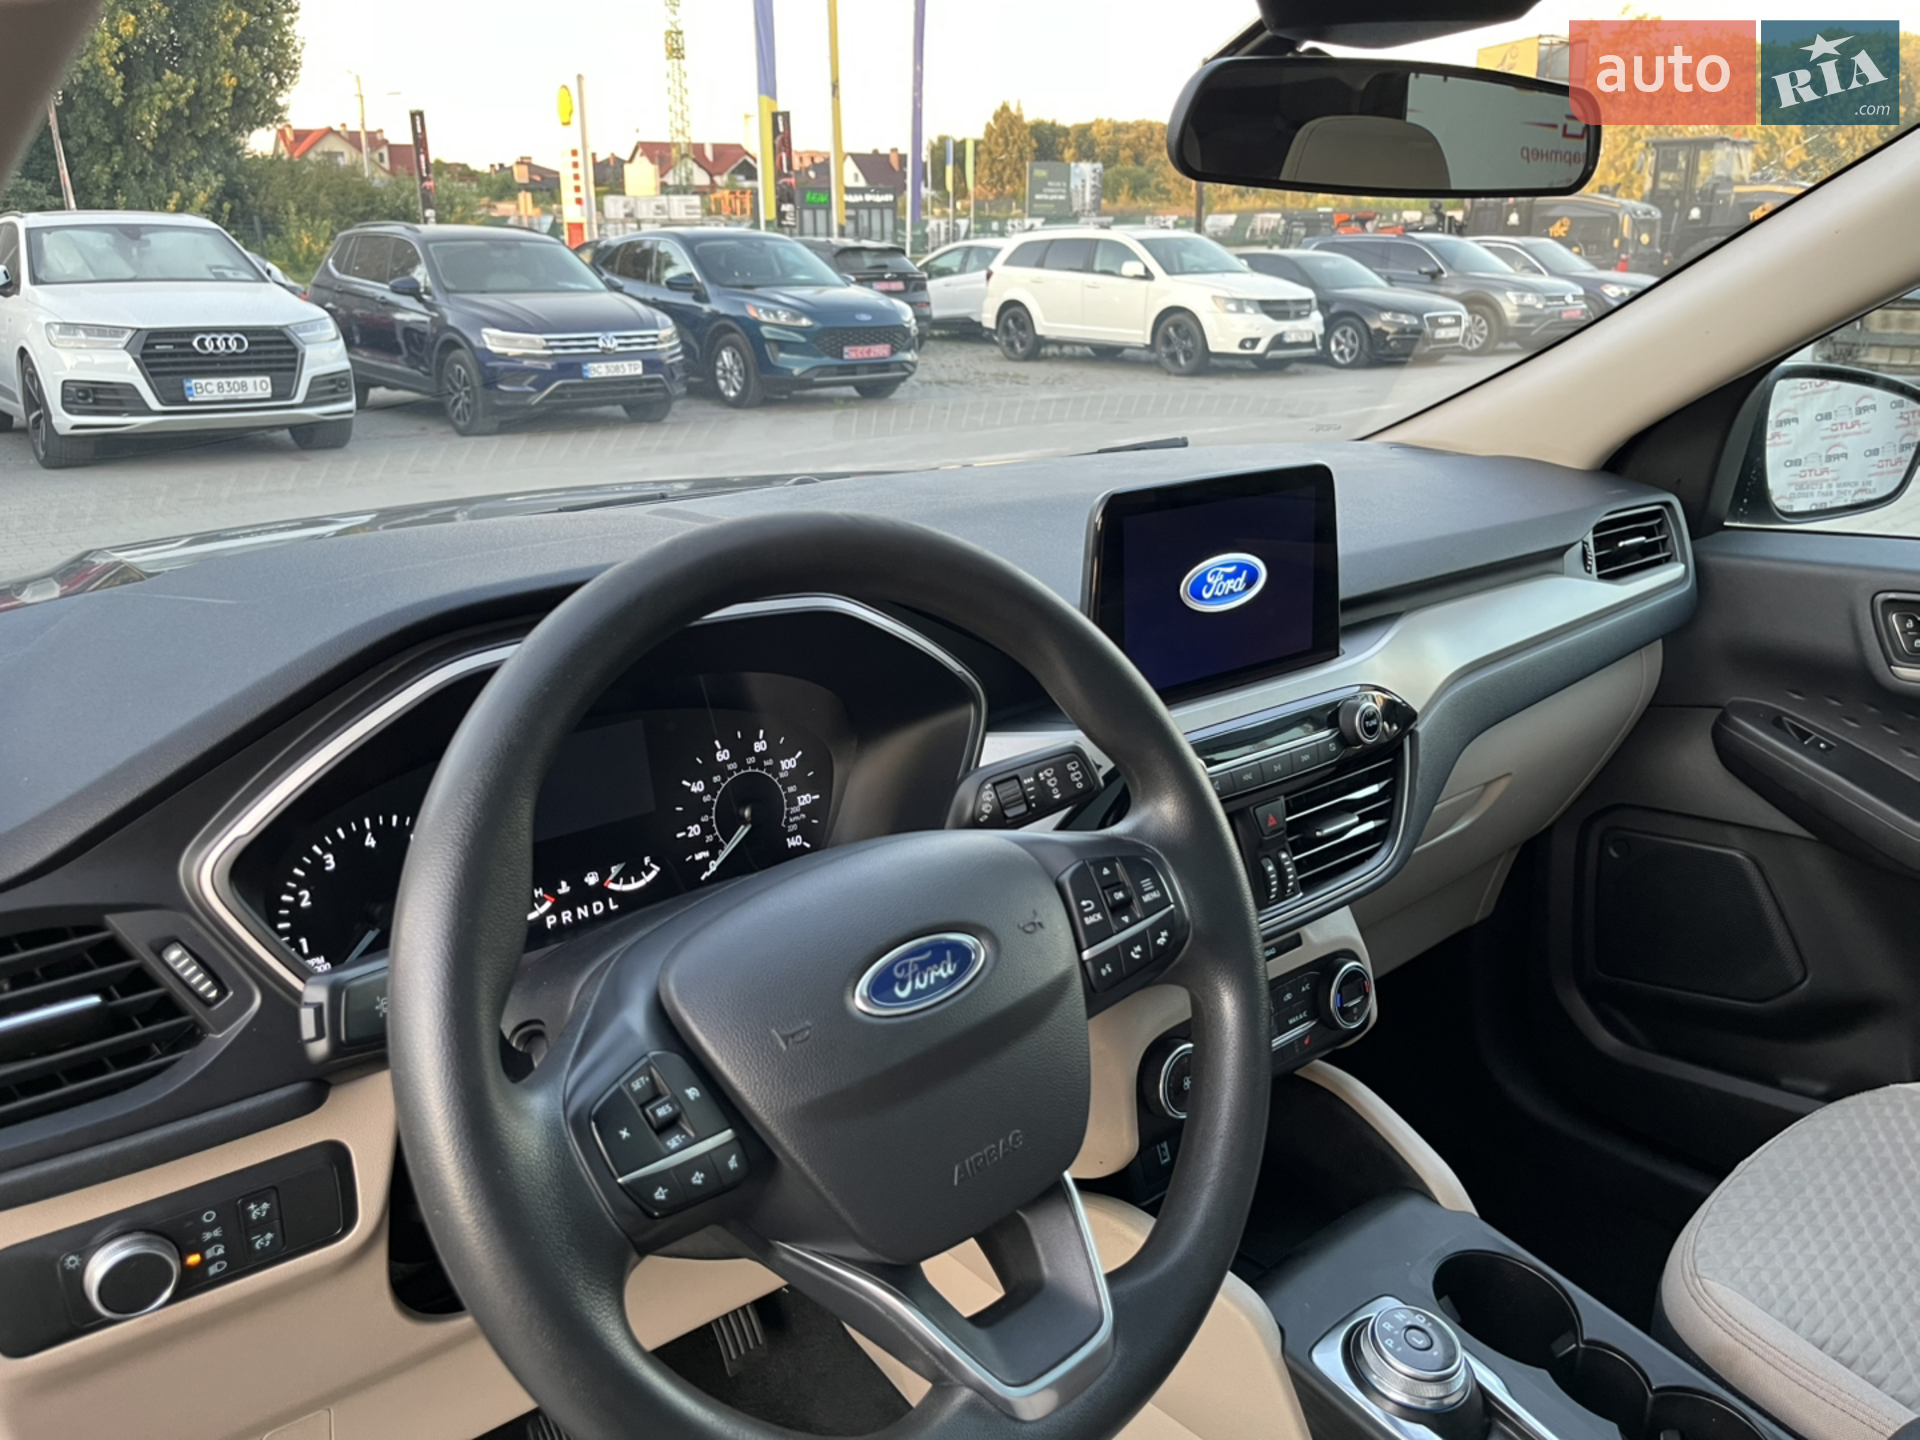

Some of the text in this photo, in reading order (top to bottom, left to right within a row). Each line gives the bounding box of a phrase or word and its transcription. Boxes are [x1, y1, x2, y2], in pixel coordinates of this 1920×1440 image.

[194, 381, 214, 394] BC
[216, 380, 248, 394] 8308
[1202, 564, 1248, 600] Ford
[753, 740, 768, 753] 80
[716, 748, 730, 762] 60
[780, 756, 797, 771] 100
[690, 780, 705, 794] 40
[796, 793, 812, 806] 120
[686, 824, 702, 838] 20
[364, 832, 377, 848] 4
[786, 834, 803, 849] 140
[322, 853, 336, 871] 3
[644, 856, 652, 866] F
[298, 890, 312, 908] 2
[534, 887, 544, 898] H
[1113, 890, 1125, 900] OK
[1142, 890, 1161, 903] MENU
[546, 897, 618, 930] P R N D L
[1084, 912, 1104, 926] BACK
[298, 938, 310, 954] 1
[893, 949, 957, 998] Ford
[630, 1076, 650, 1092] SET+
[655, 1104, 673, 1118] RES
[953, 1129, 1024, 1186] AIRBAG
